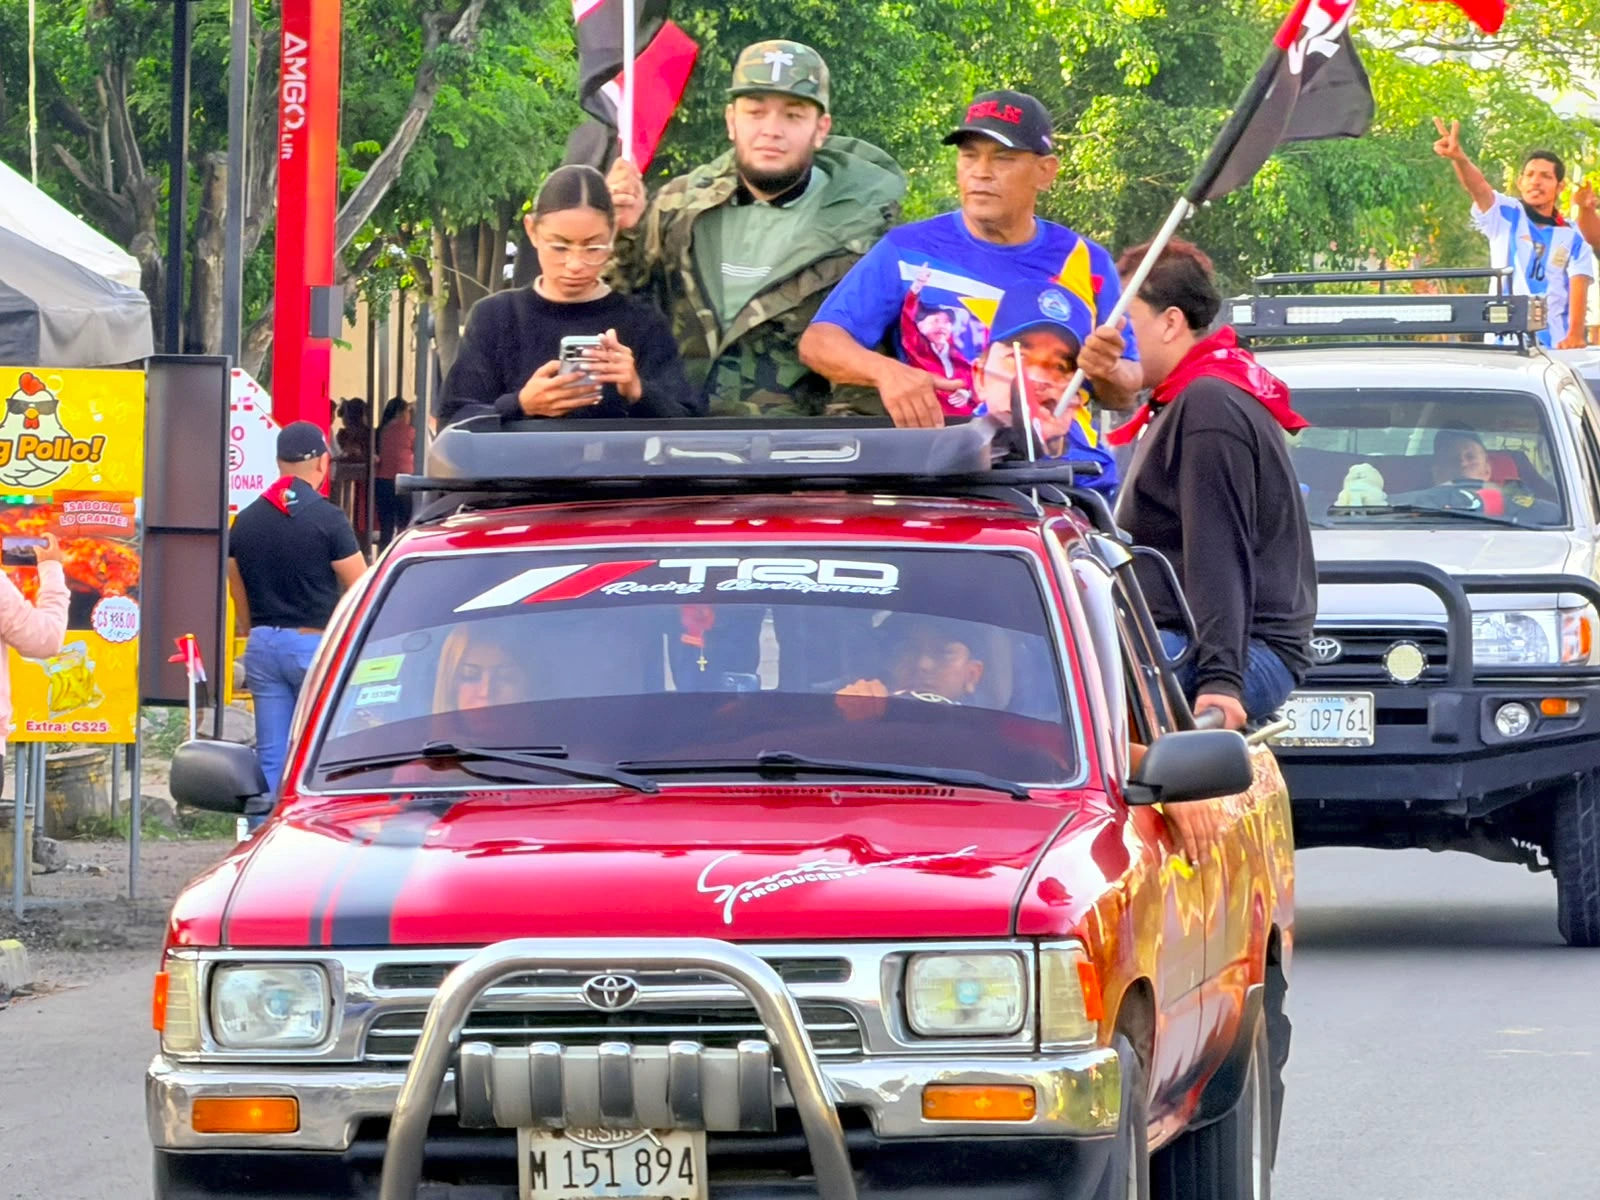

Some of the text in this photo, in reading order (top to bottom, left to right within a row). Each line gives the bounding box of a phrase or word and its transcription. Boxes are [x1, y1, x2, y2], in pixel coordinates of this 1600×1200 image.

[230, 425, 245, 441] O
[16, 434, 106, 463] Pollo!
[230, 475, 263, 490] IONAR
[658, 557, 899, 587] TRD
[600, 581, 704, 596] Racing
[26, 720, 67, 732] Extra:
[1310, 708, 1368, 732] 09761
[739, 872, 844, 903] PRODUCED
[529, 1147, 695, 1190] M 151 894
